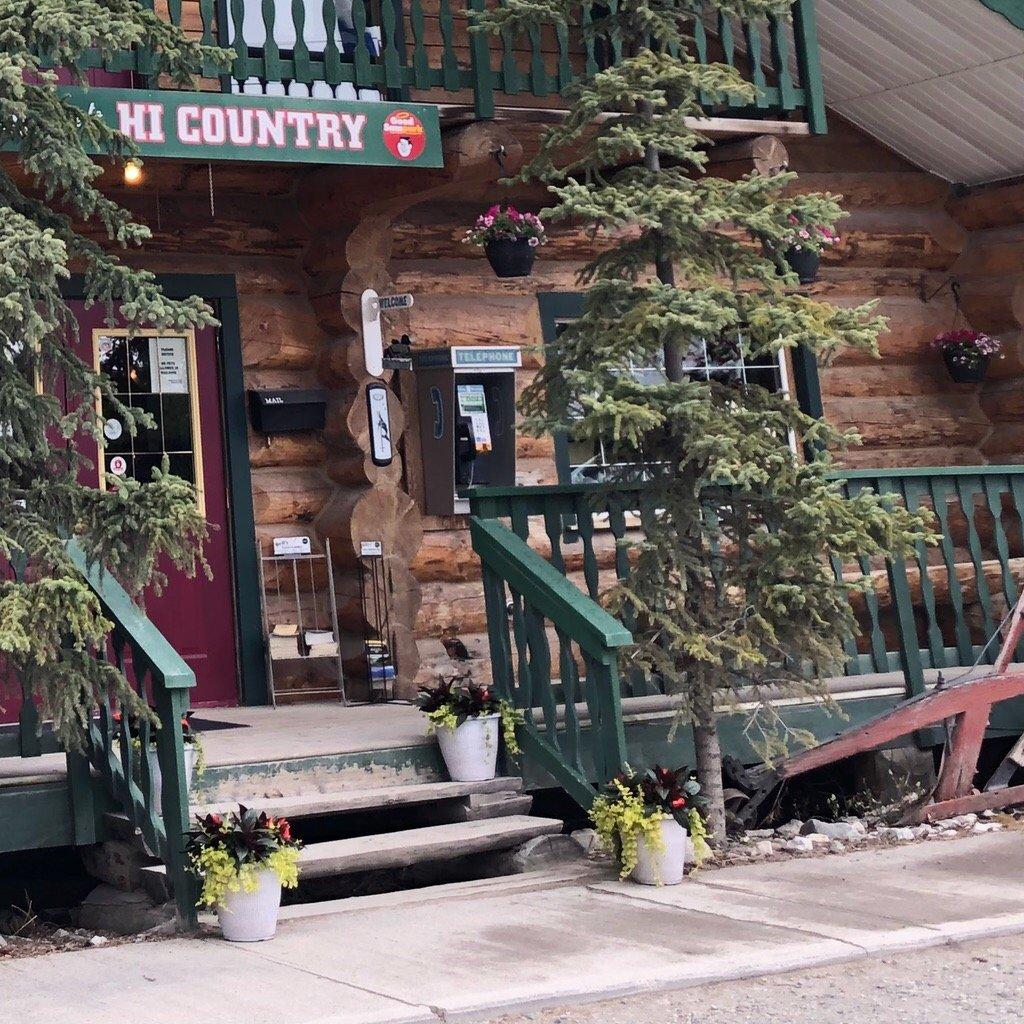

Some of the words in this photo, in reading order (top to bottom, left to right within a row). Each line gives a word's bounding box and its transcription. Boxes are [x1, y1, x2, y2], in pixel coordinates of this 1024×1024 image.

[116, 102, 165, 143] HI
[176, 105, 368, 150] COUNTRY
[379, 295, 407, 308] WELCOME
[457, 351, 515, 362] TELEPHONE
